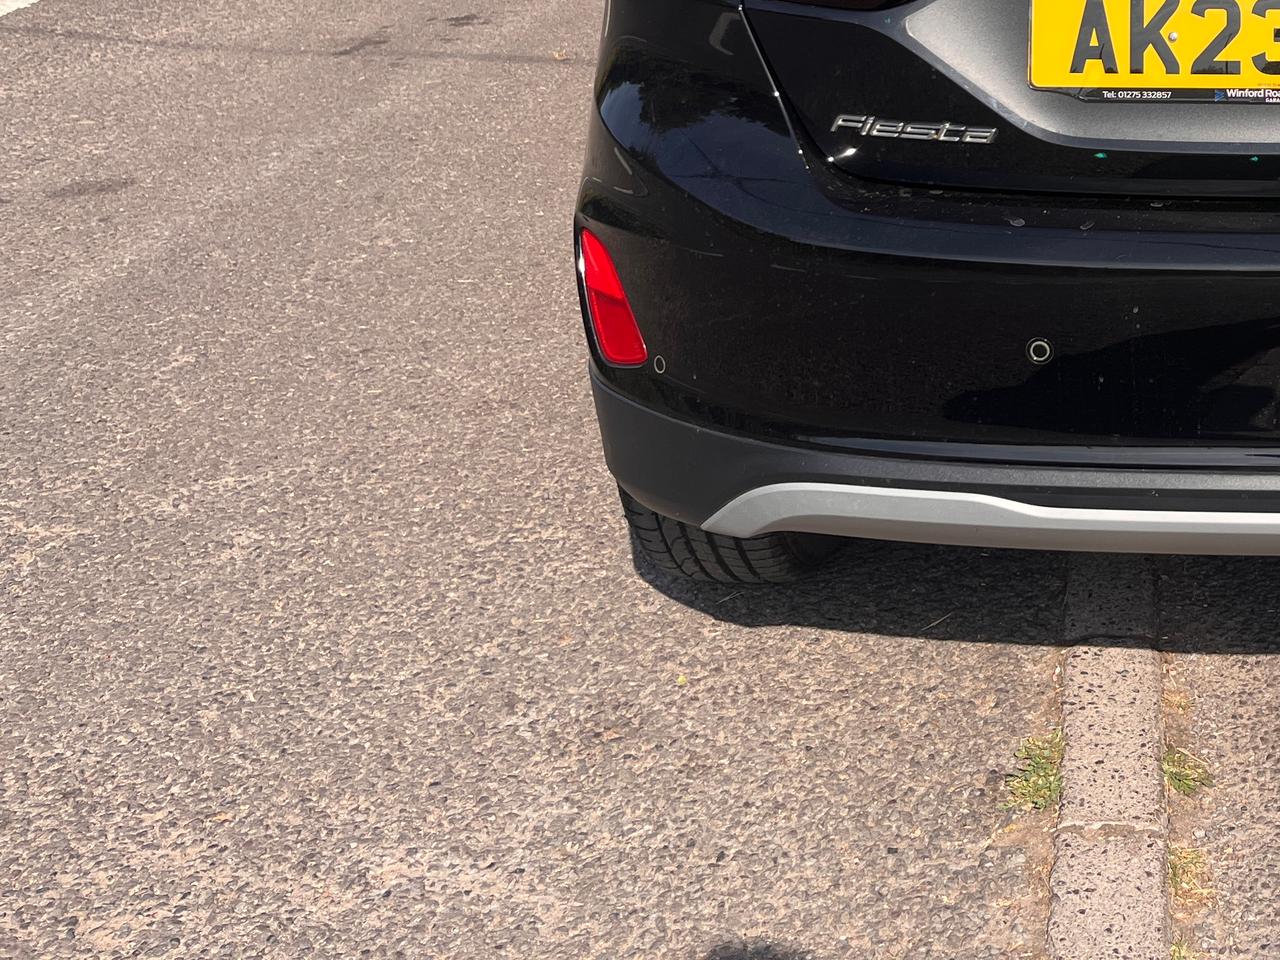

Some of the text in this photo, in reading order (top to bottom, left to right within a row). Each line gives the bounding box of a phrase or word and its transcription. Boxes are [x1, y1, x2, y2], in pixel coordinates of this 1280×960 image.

[1102, 90, 1172, 99] Tel: 01275 332857
[1226, 88, 1265, 98] Winford
[830, 114, 997, 144] Fiesta
